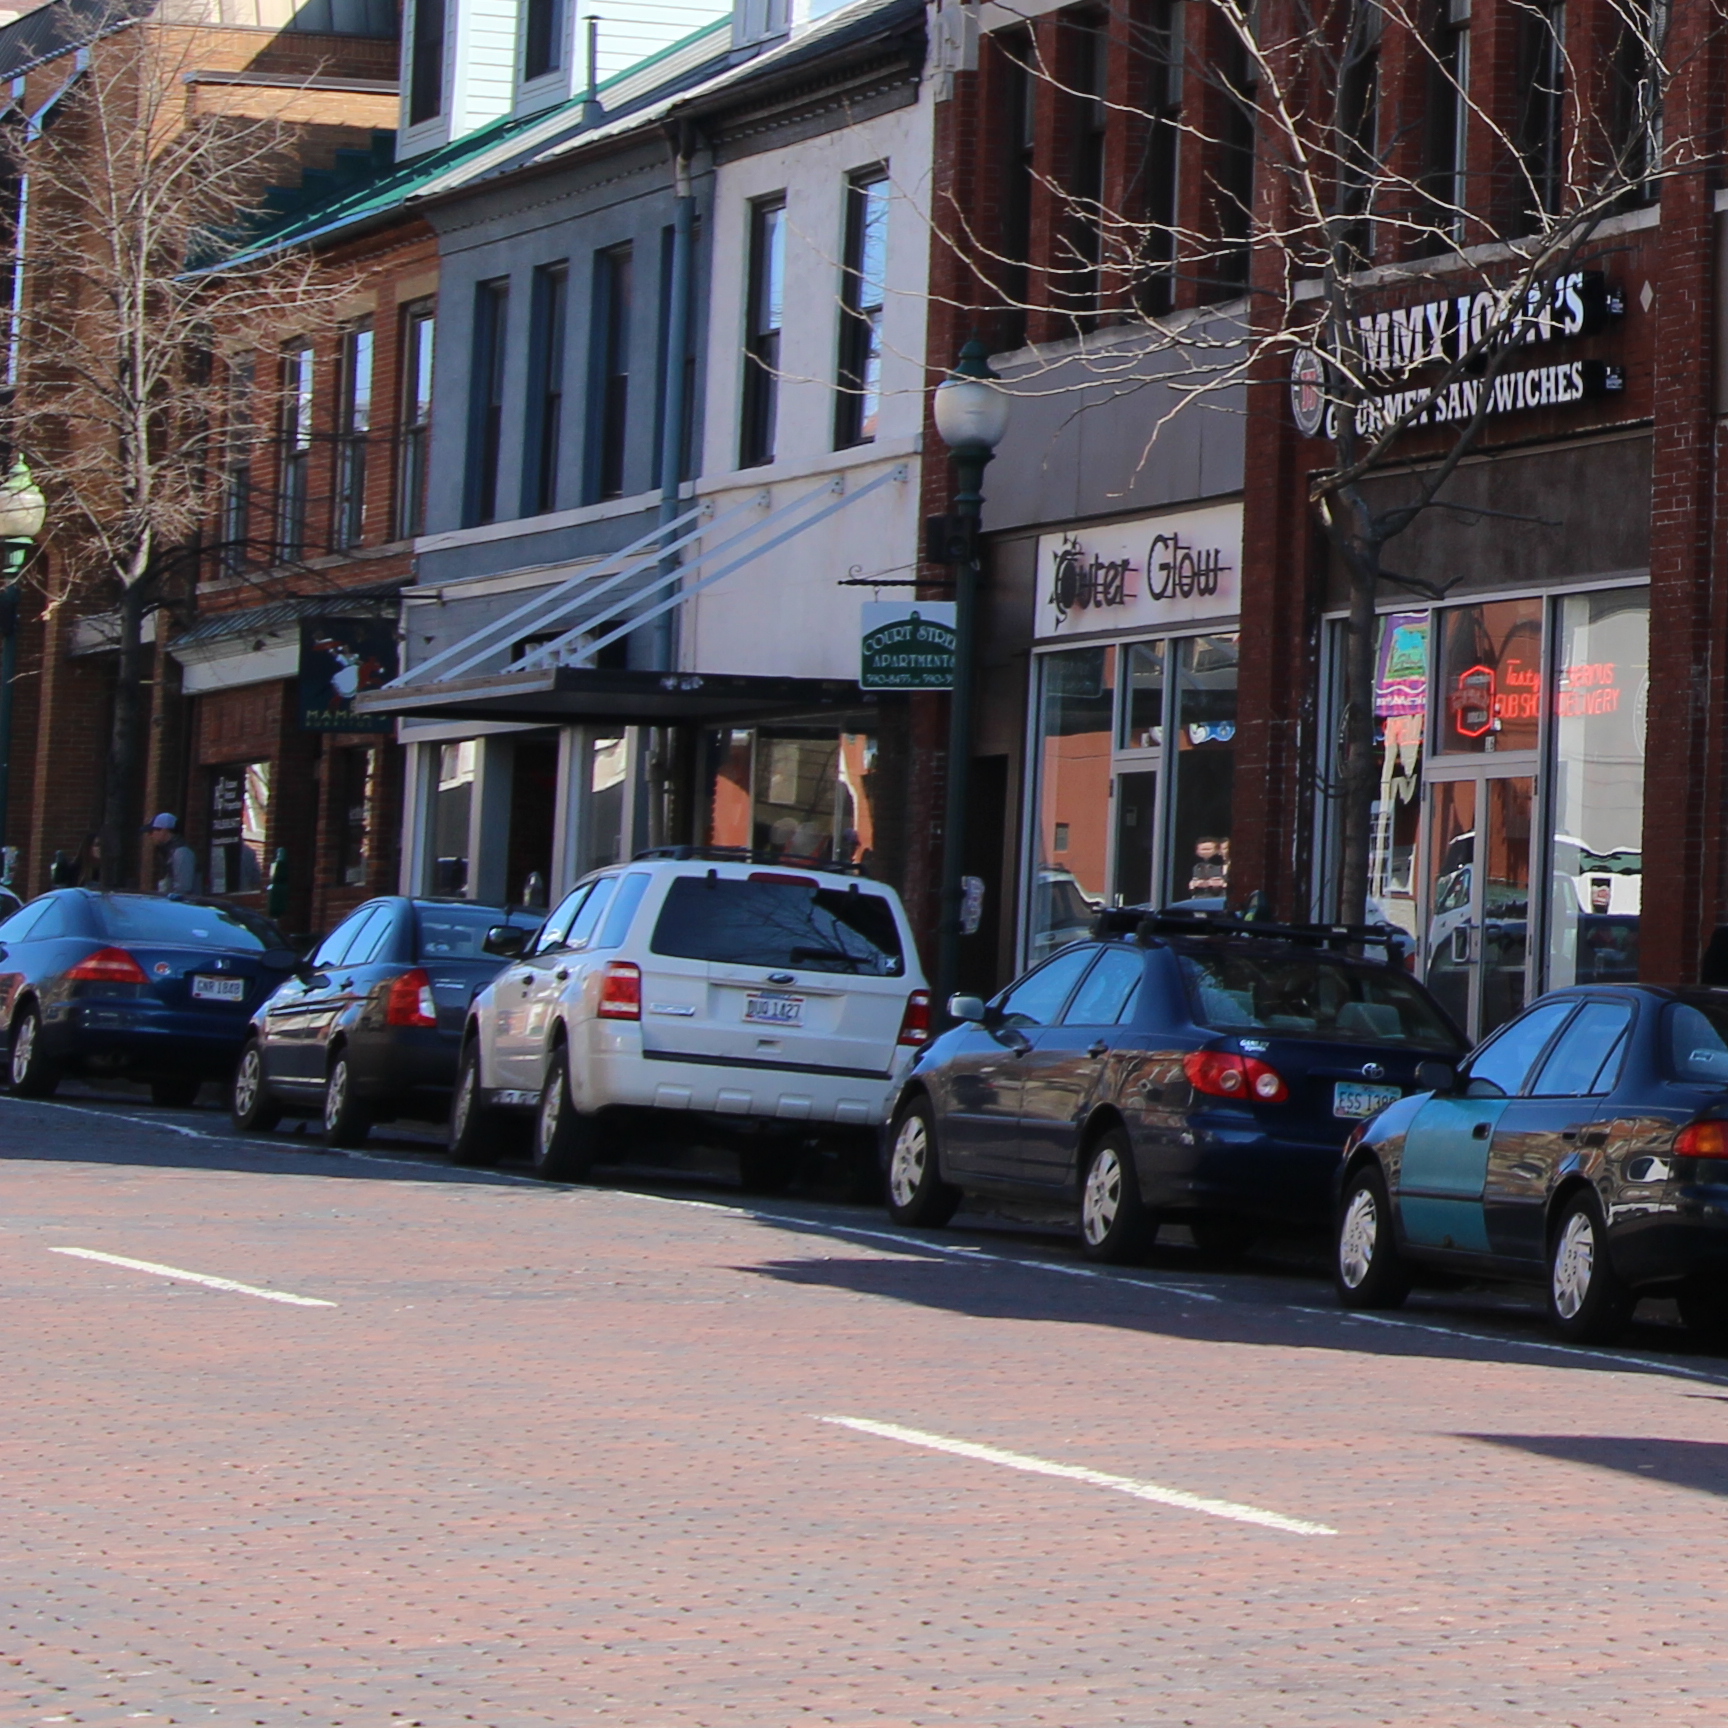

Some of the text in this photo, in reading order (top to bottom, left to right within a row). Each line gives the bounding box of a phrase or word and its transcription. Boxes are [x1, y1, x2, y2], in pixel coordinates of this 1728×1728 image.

[1147, 532, 1231, 601] Glow
[863, 625, 913, 655] COURT
[1340, 1091, 1362, 1110] ESS
